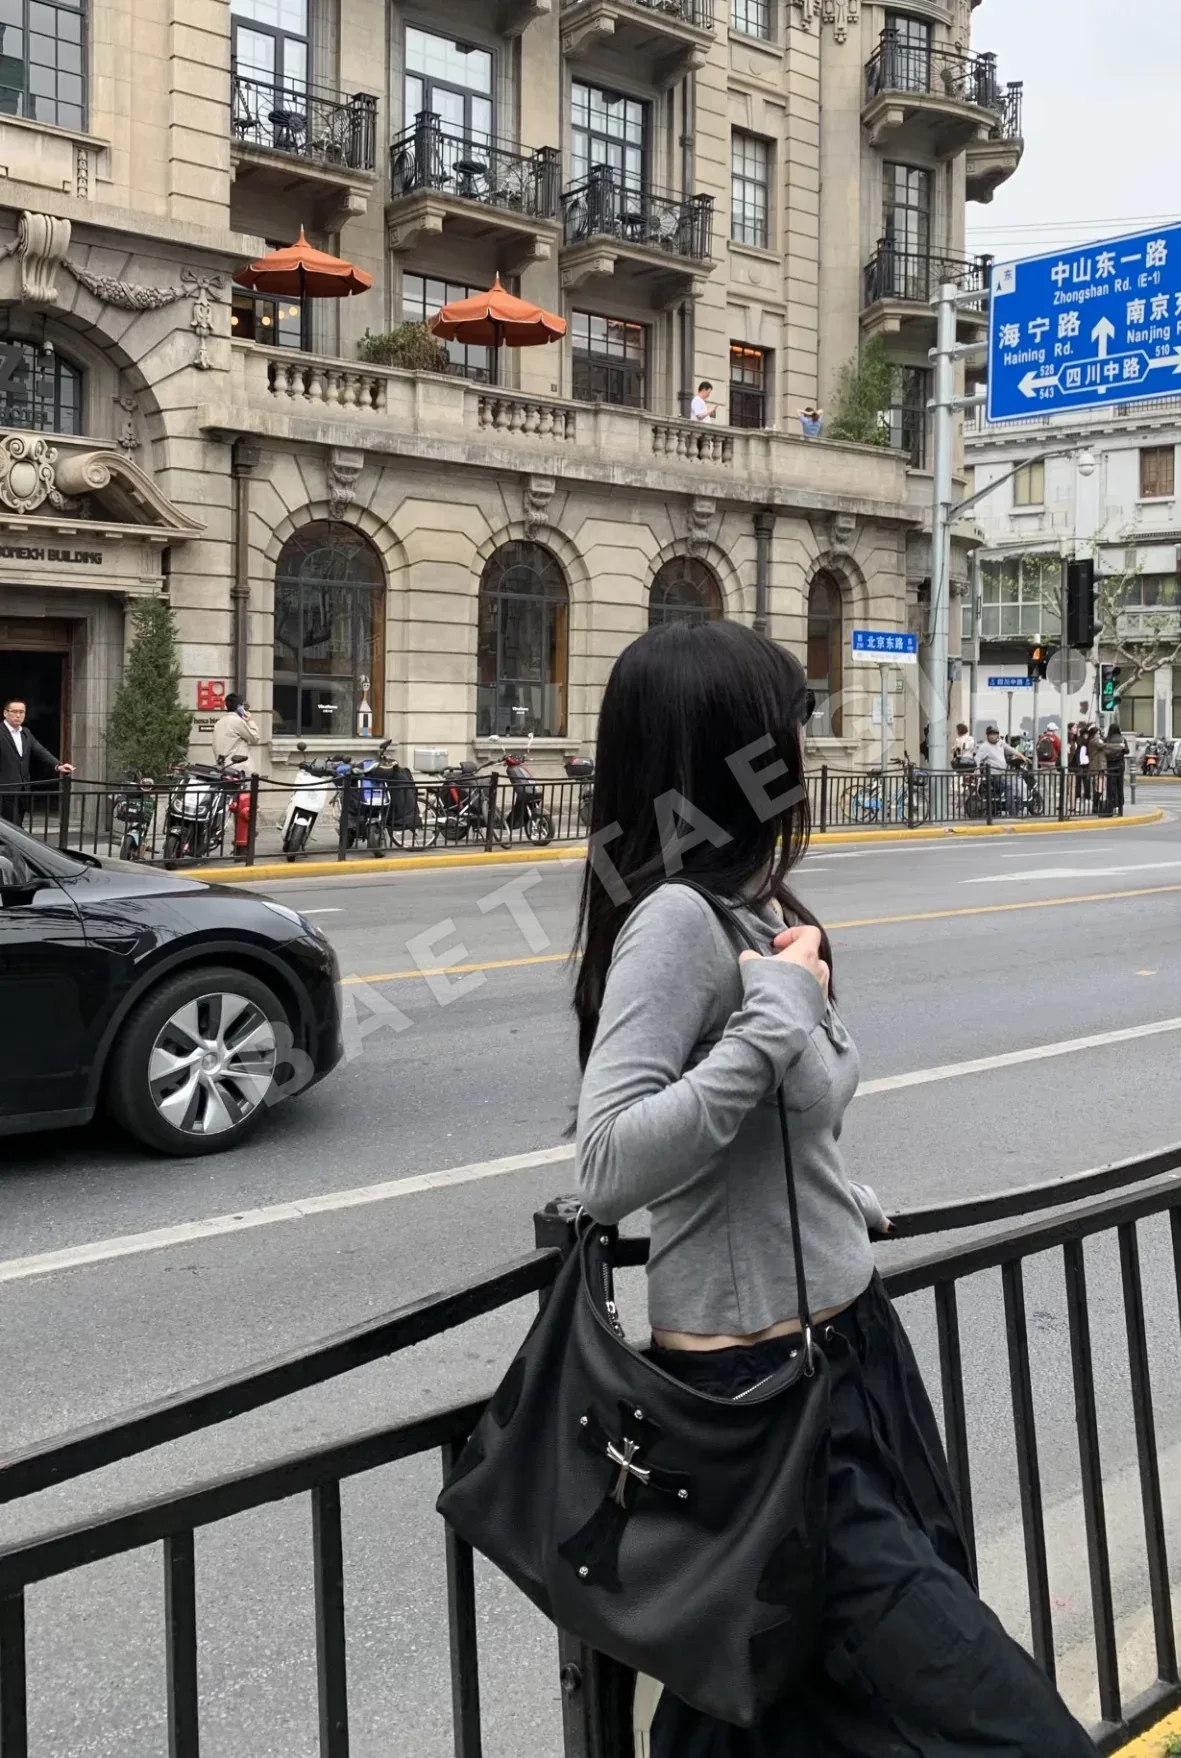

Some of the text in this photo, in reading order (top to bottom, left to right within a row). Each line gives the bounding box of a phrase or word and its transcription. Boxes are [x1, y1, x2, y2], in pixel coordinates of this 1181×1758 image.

[1051, 239, 1168, 288] 中山东一路
[1053, 271, 1161, 305] Zhongshan Rd. (E-1)
[998, 310, 1081, 350] 海宁路
[1127, 324, 1170, 344] Nanjing
[1004, 341, 1074, 366] Haining Rd.
[1155, 344, 1170, 357] 510
[1040, 364, 1055, 377] 528
[1066, 357, 1141, 388] 四川中路
[1039, 387, 1054, 400] 543
[48, 549, 102, 565] BUILDING
[866, 635, 904, 650] 北京东路
